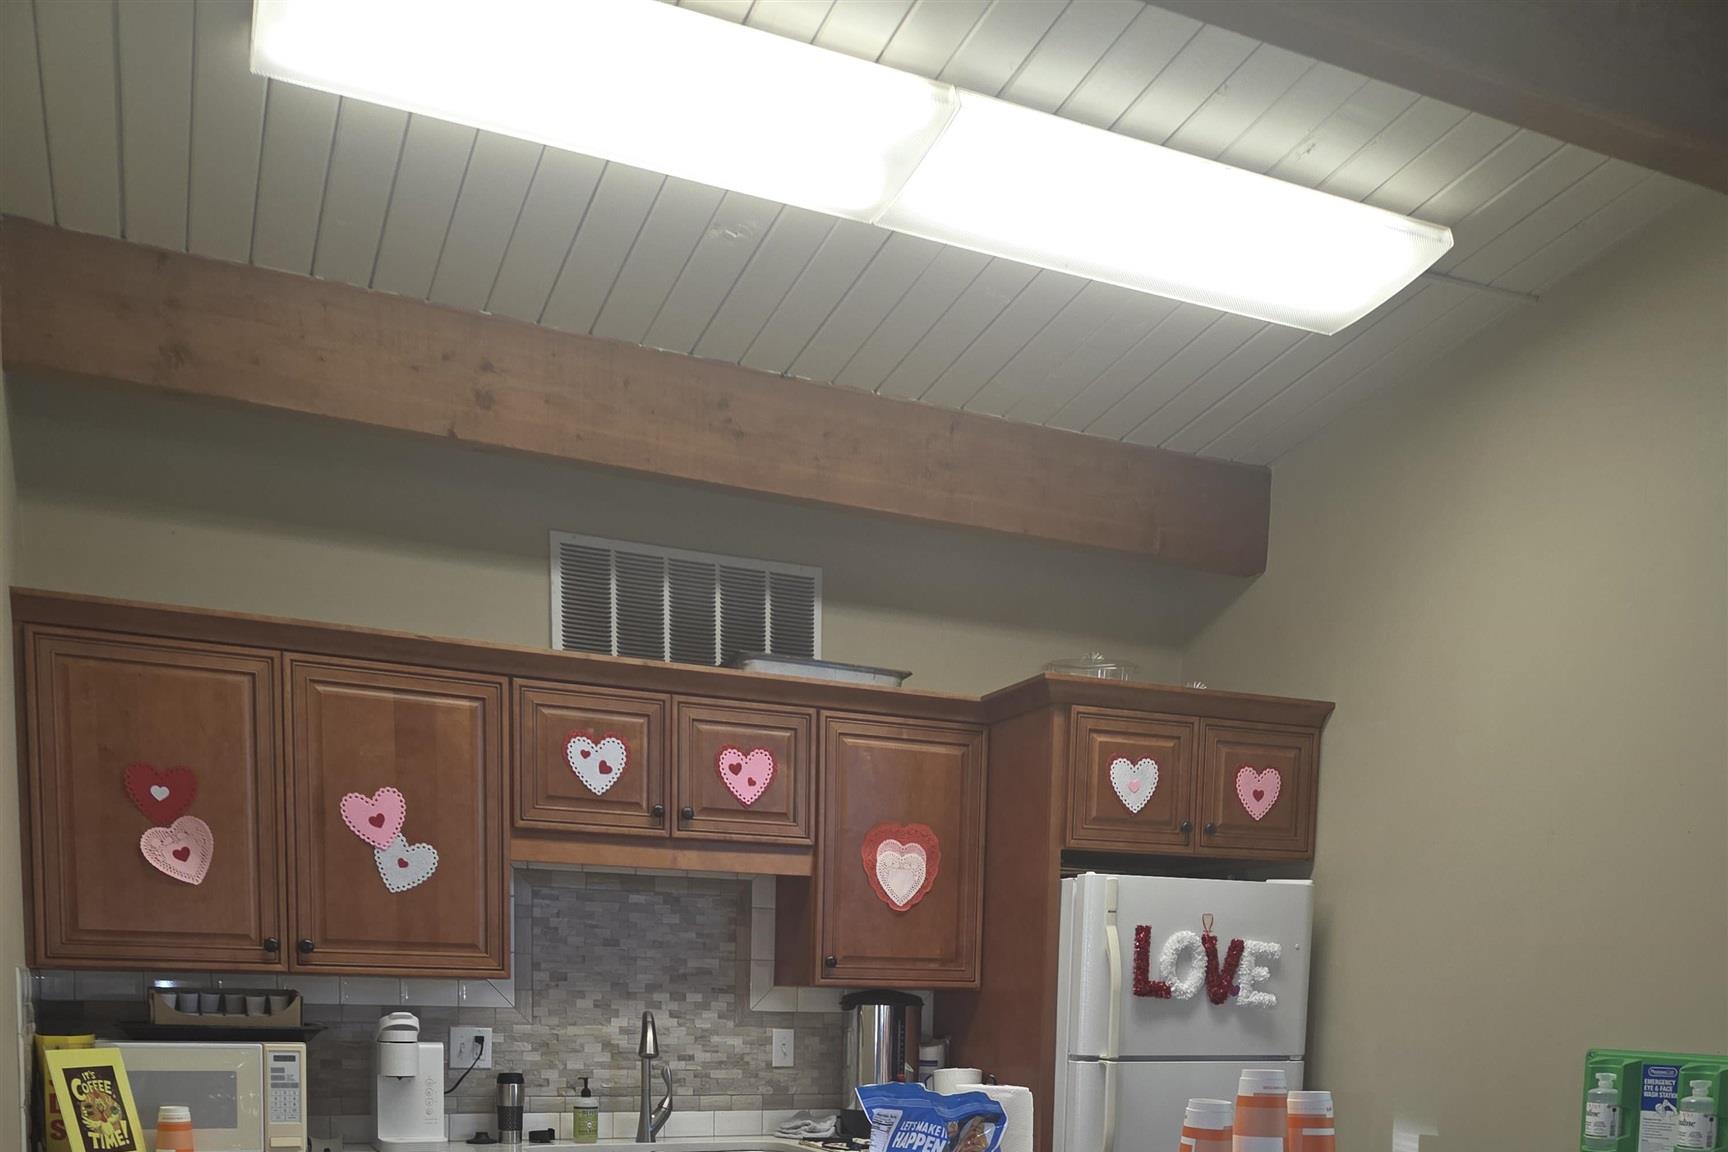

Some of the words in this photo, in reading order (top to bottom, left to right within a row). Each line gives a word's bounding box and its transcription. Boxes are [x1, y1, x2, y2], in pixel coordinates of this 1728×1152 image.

[1133, 925, 1282, 1008] LOVE
[81, 1071, 96, 1080] IT'S
[71, 1078, 112, 1101] COFFEE
[88, 1120, 130, 1149] TIME!
[916, 1121, 941, 1137] MAKE
